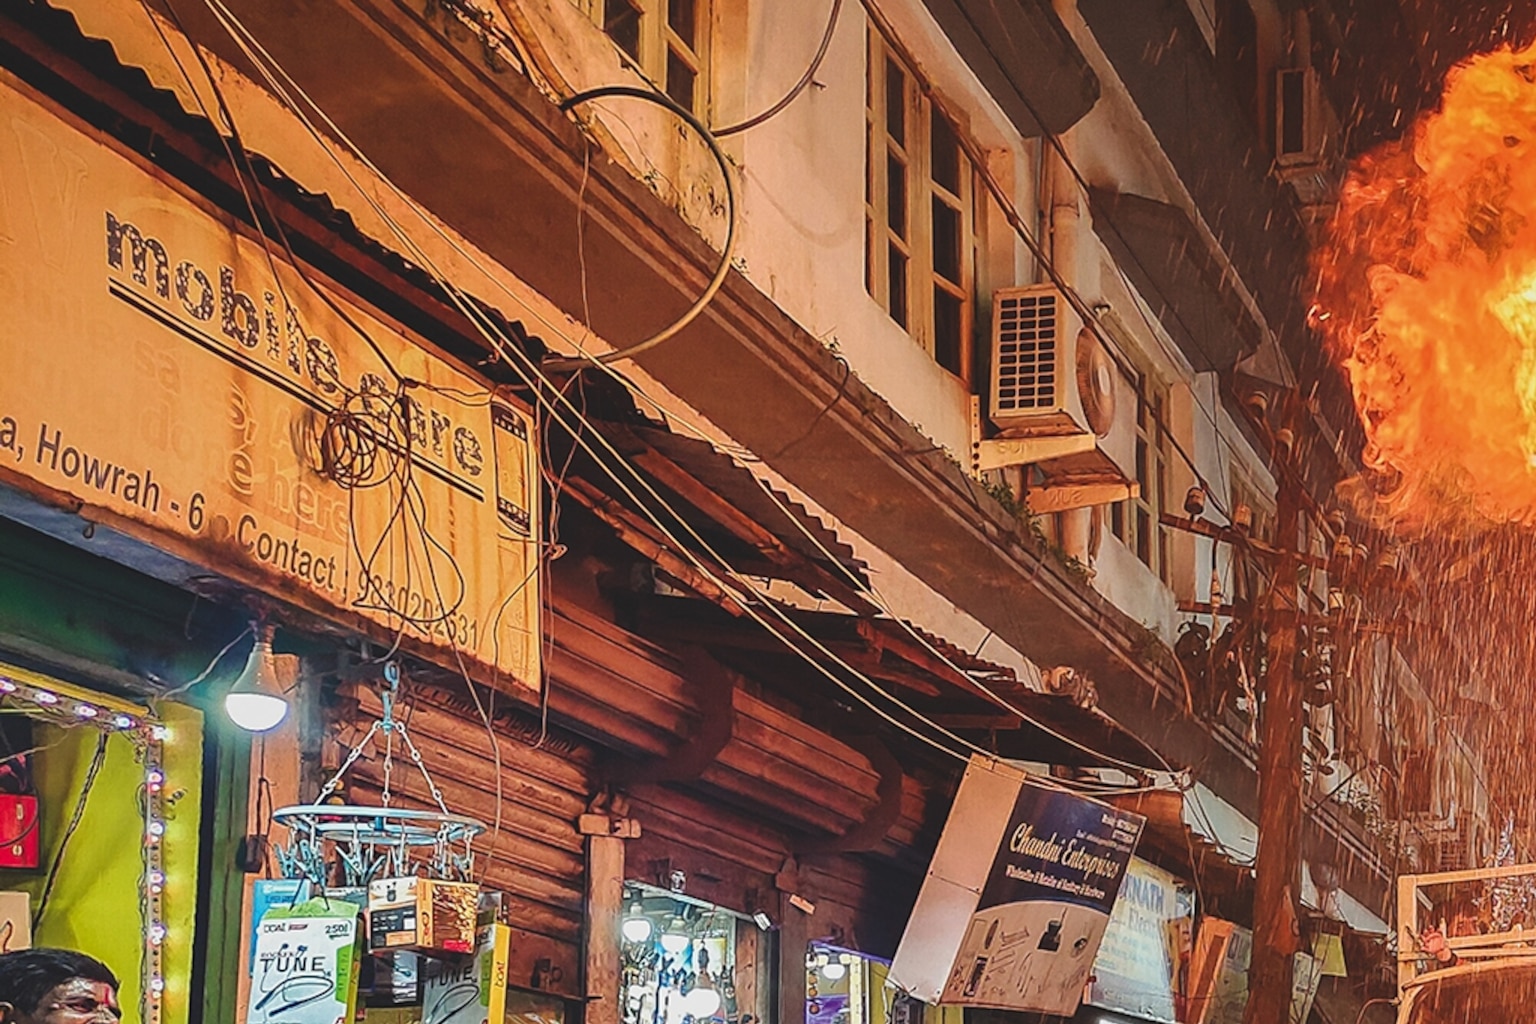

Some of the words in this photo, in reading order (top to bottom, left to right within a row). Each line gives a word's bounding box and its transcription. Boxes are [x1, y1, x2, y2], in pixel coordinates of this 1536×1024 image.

[105, 211, 339, 394] mobile
[36, 423, 160, 512] Howrah
[188, 492, 205, 530] 6
[237, 514, 337, 590] Contact
[1009, 822, 1067, 864] Chandni
[1061, 838, 1120, 881] Enterprises
[260, 956, 326, 973] TUNE
